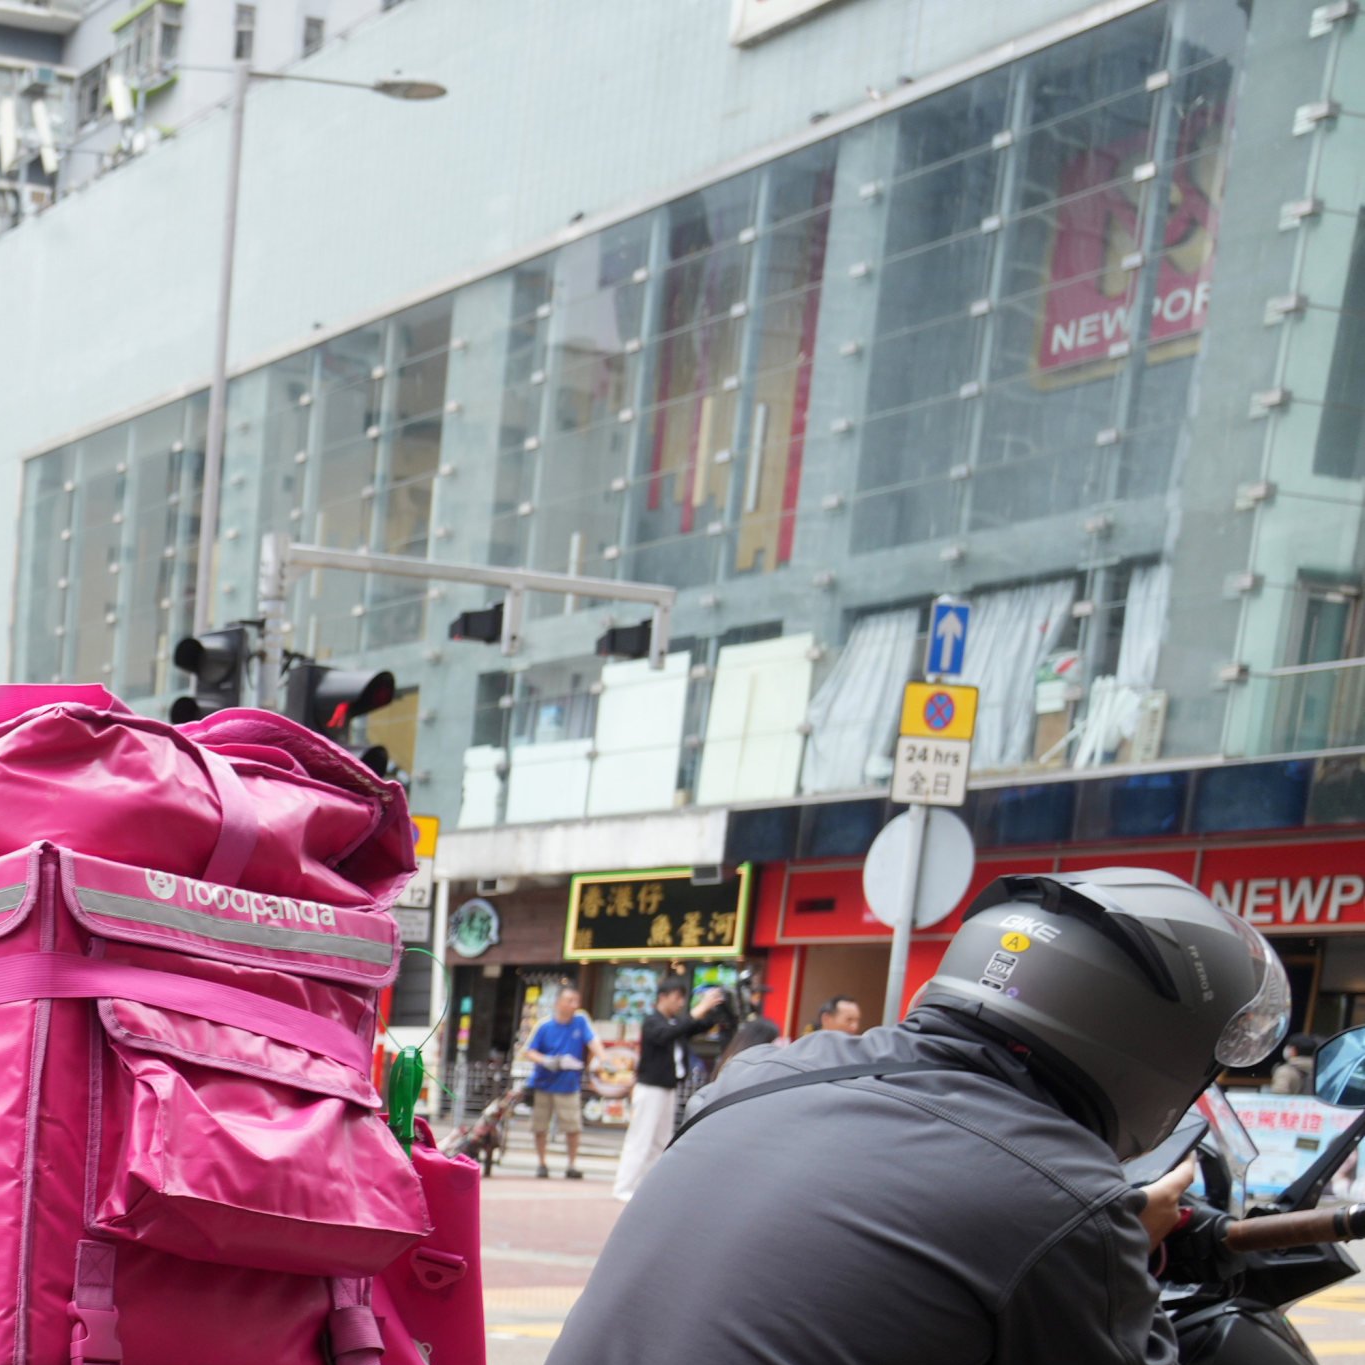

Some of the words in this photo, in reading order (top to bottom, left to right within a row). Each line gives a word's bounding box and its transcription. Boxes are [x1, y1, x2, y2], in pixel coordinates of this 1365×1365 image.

[1051, 281, 1212, 355] NEWO
[906, 745, 928, 763] 24
[934, 748, 960, 766] hrs
[907, 770, 950, 797] 全日
[184, 875, 337, 927] foodpanda
[581, 884, 664, 919] 香港仔
[1211, 875, 1365, 923] NEWP
[1005, 935, 1020, 950] A
